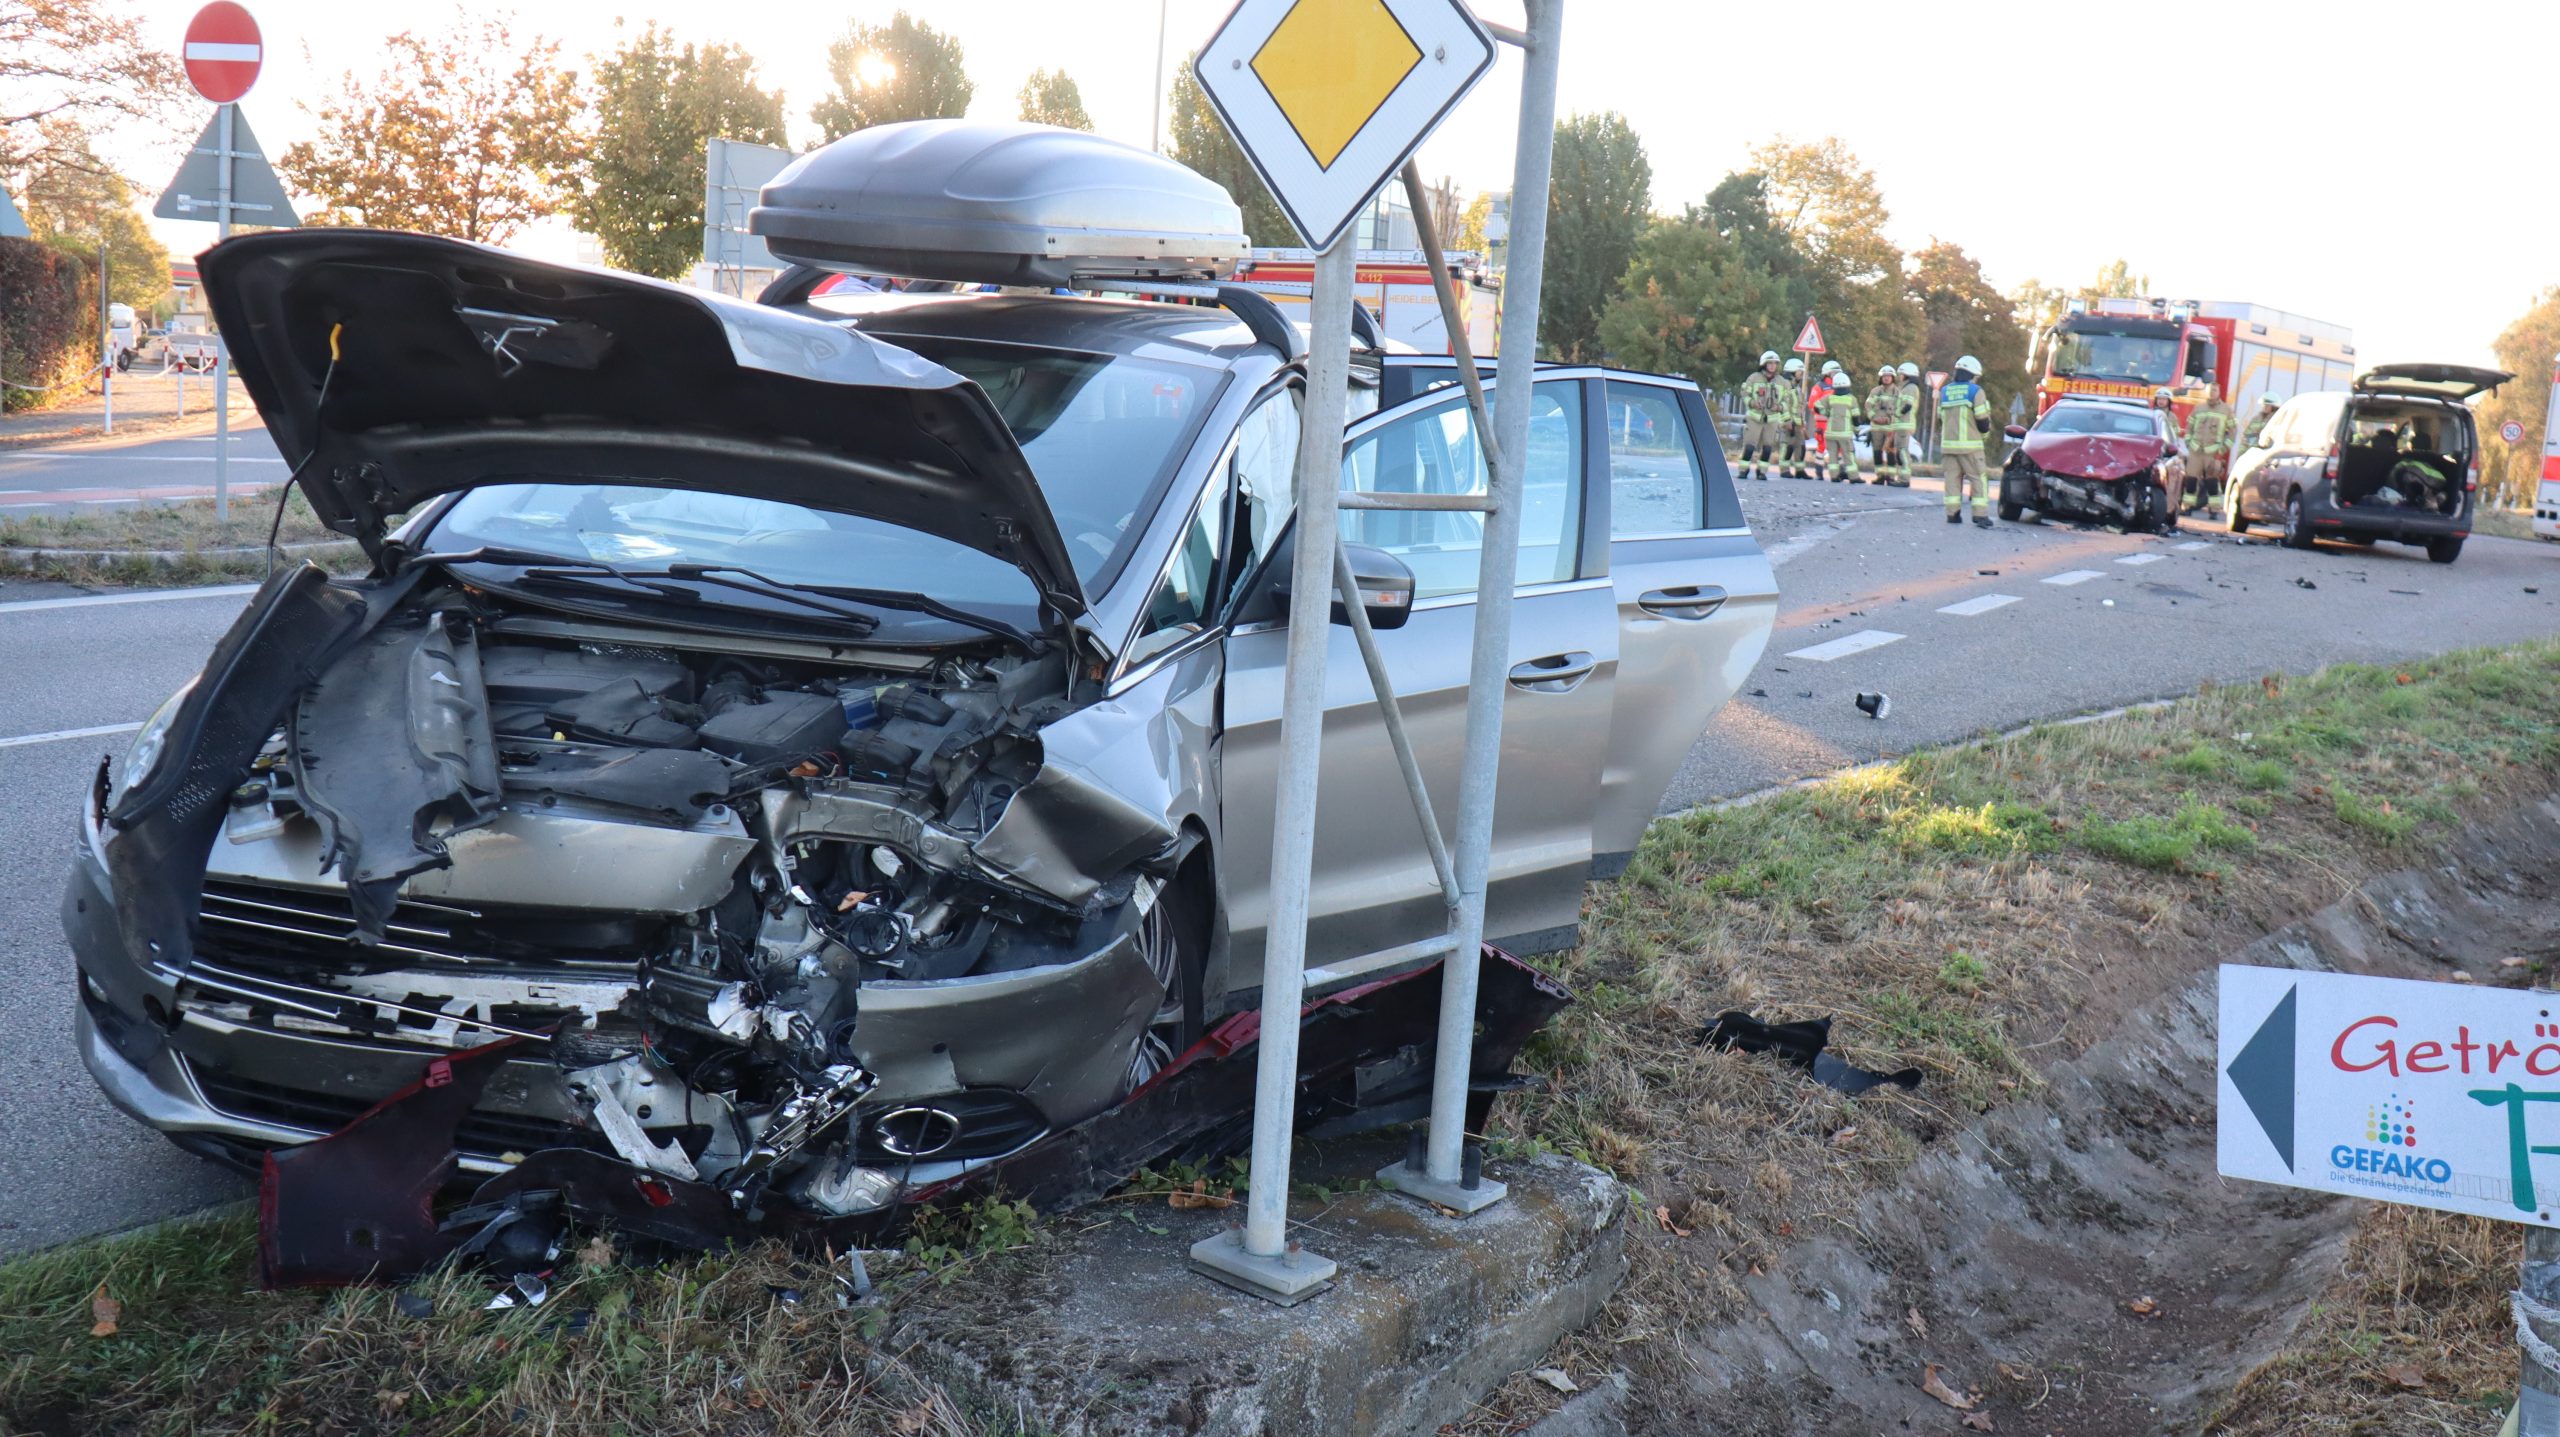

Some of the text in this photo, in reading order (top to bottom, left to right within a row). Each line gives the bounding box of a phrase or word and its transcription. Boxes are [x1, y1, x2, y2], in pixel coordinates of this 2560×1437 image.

[1367, 273, 1383, 282] 112
[1390, 295, 1440, 304] HEIDELBER
[2063, 381, 2149, 398] FEUERWEHR
[2505, 426, 2520, 437] 50
[2331, 1145, 2452, 1184] GEFAKO
[2330, 1171, 2346, 1182] Die
